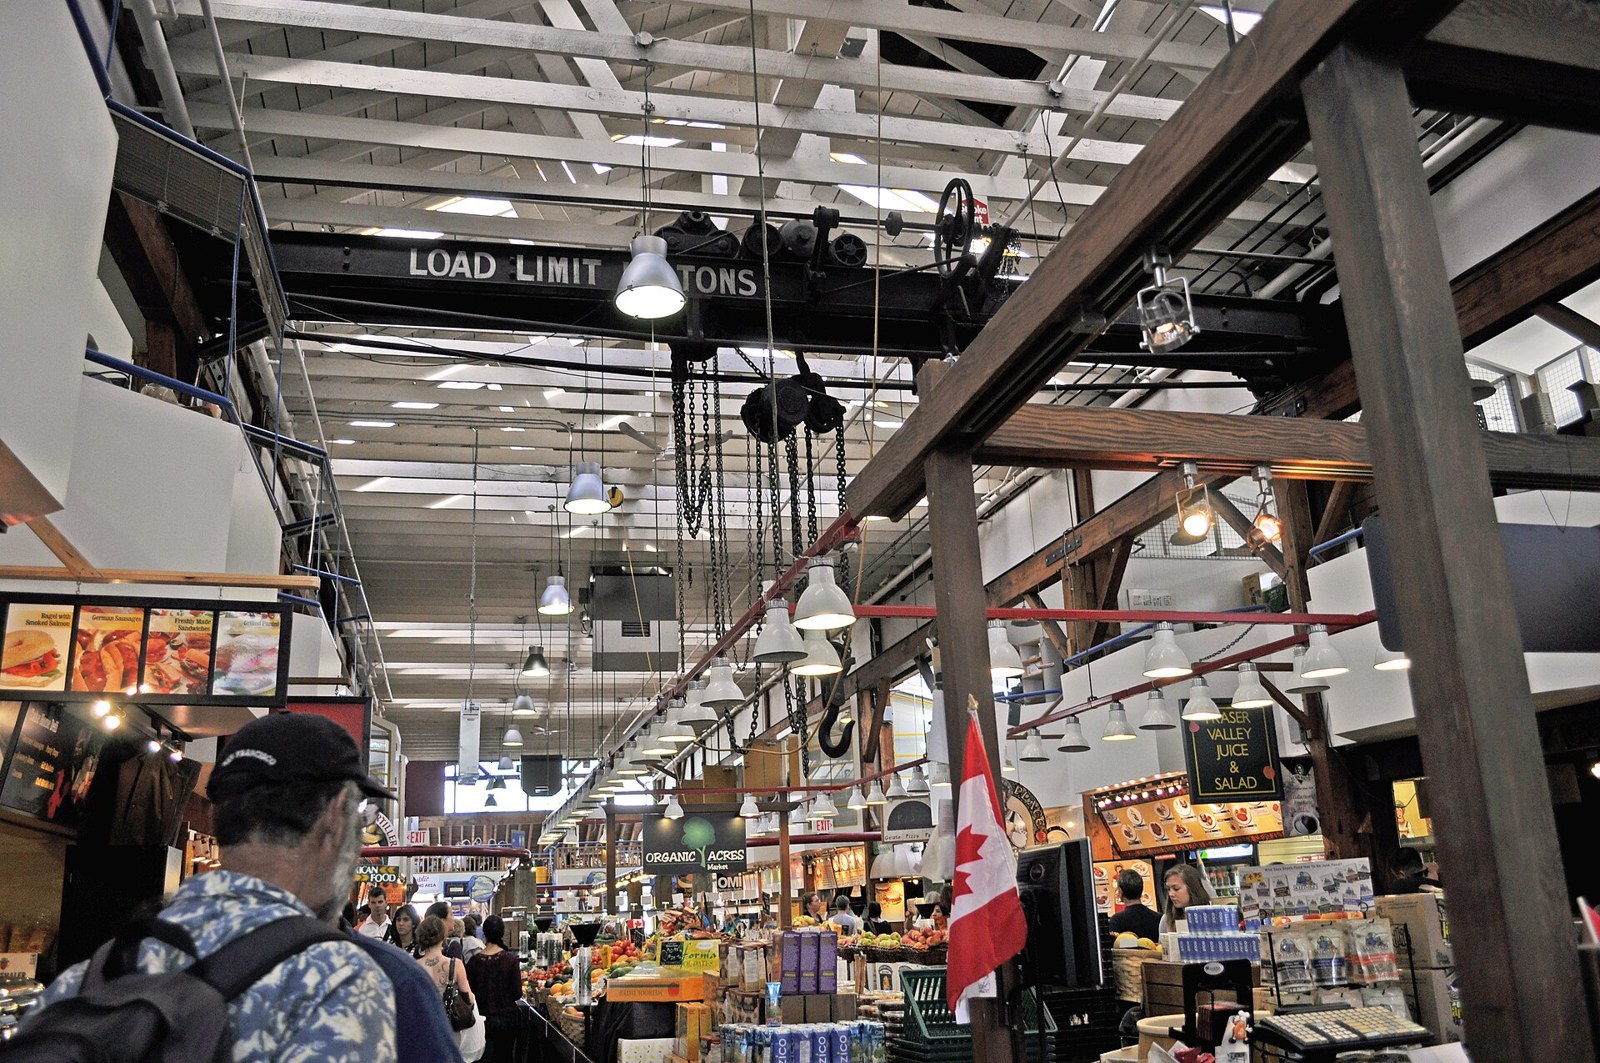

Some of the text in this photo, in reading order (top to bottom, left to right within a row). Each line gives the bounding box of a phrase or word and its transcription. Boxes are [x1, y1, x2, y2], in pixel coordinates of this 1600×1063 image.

[408, 248, 758, 297] LOAD LIMIT TONS
[174, 617, 212, 625] Freshly Made
[178, 624, 211, 632] Sandwiches
[1207, 727, 1252, 741] VALLEY
[1216, 743, 1249, 761] JUICE
[1229, 760, 1239, 773] &
[1214, 776, 1257, 791] SALAD
[816, 819, 830, 831] EXIT
[410, 831, 426, 843] EXIT
[645, 849, 744, 863] ORGANIC ACRES
[370, 873, 397, 882] FOOD
[836, 1034, 848, 1063] zico
